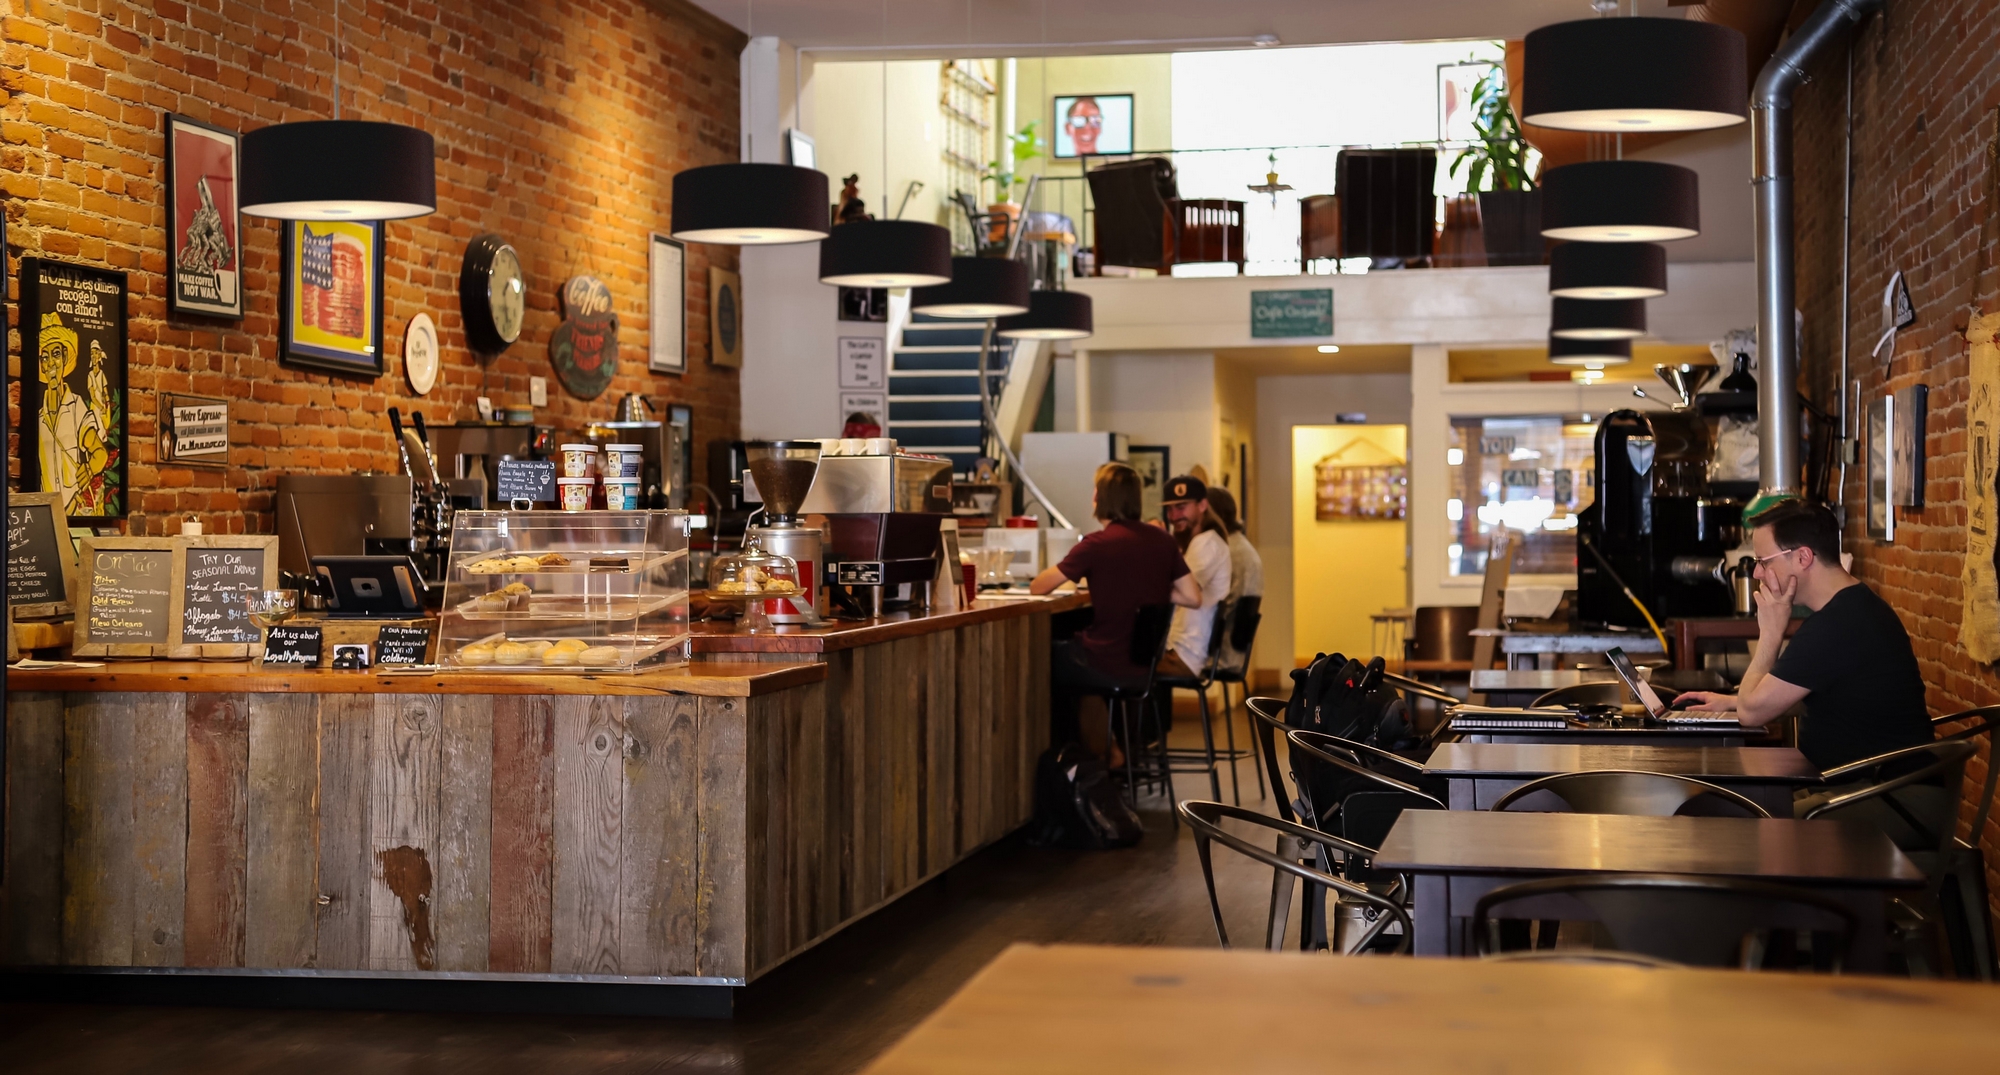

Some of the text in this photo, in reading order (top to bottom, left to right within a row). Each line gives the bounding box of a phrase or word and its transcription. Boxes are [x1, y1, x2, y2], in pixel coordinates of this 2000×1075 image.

[94, 278, 120, 295] dinero
[179, 273, 214, 287] MAKE COFFEE
[184, 284, 218, 300] NOT WAR.
[569, 276, 609, 316] Coffee
[56, 302, 73, 314] con
[180, 408, 222, 425] Notre Espresso
[1481, 437, 1514, 453] YOU
[1503, 470, 1538, 487] CAN
[24, 509, 34, 524] A
[96, 553, 122, 571] On
[233, 564, 257, 576] DRINKS
[90, 617, 143, 628] New Orleans
[269, 627, 319, 640] Ask us about
